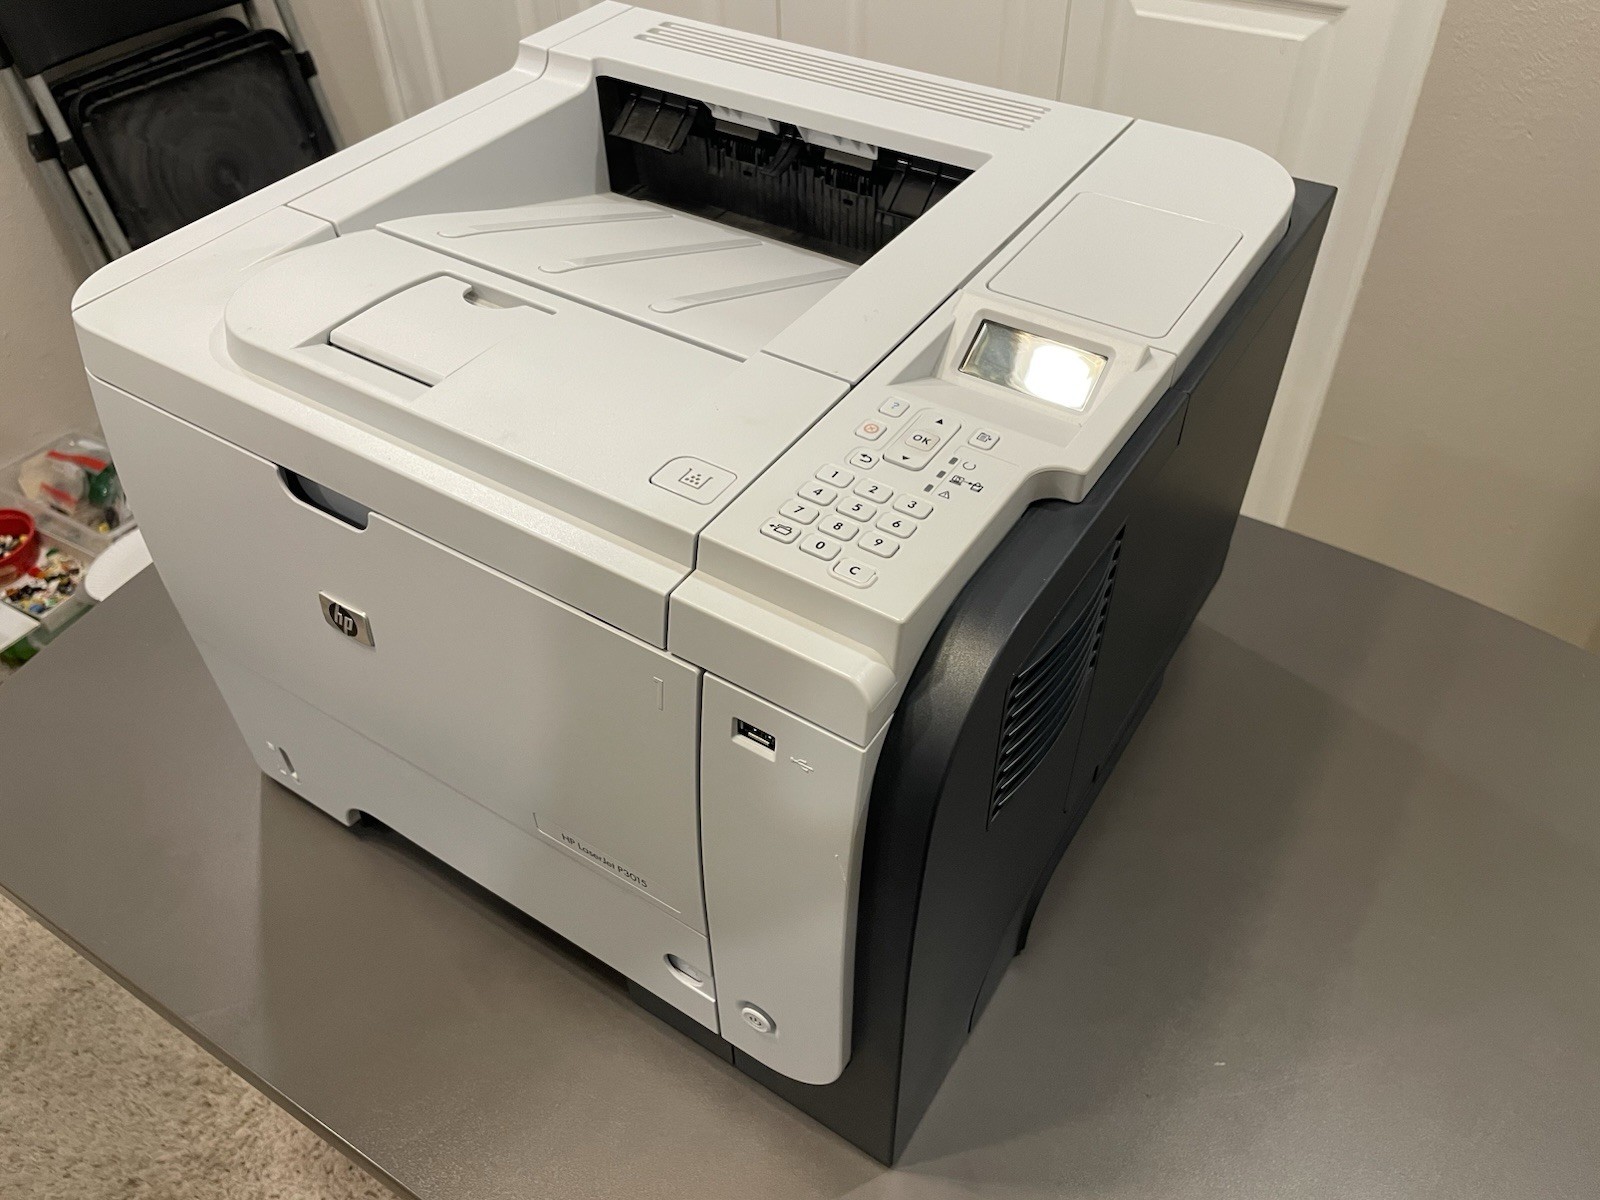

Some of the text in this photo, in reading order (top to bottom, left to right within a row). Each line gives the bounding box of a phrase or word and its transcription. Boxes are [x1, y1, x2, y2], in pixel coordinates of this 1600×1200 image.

[912, 434, 932, 446] OK
[831, 470, 839, 478] 1
[812, 488, 824, 496] 4
[868, 485, 879, 494] 2
[793, 505, 805, 513] 7
[851, 503, 862, 512] 5
[907, 500, 918, 509] 3
[832, 521, 844, 531] 8
[891, 519, 902, 528] 6
[815, 541, 826, 550] 0
[873, 538, 884, 547] 9
[849, 566, 861, 576] C
[333, 603, 355, 635] hp
[561, 832, 649, 888] HP LaserJet P3015
